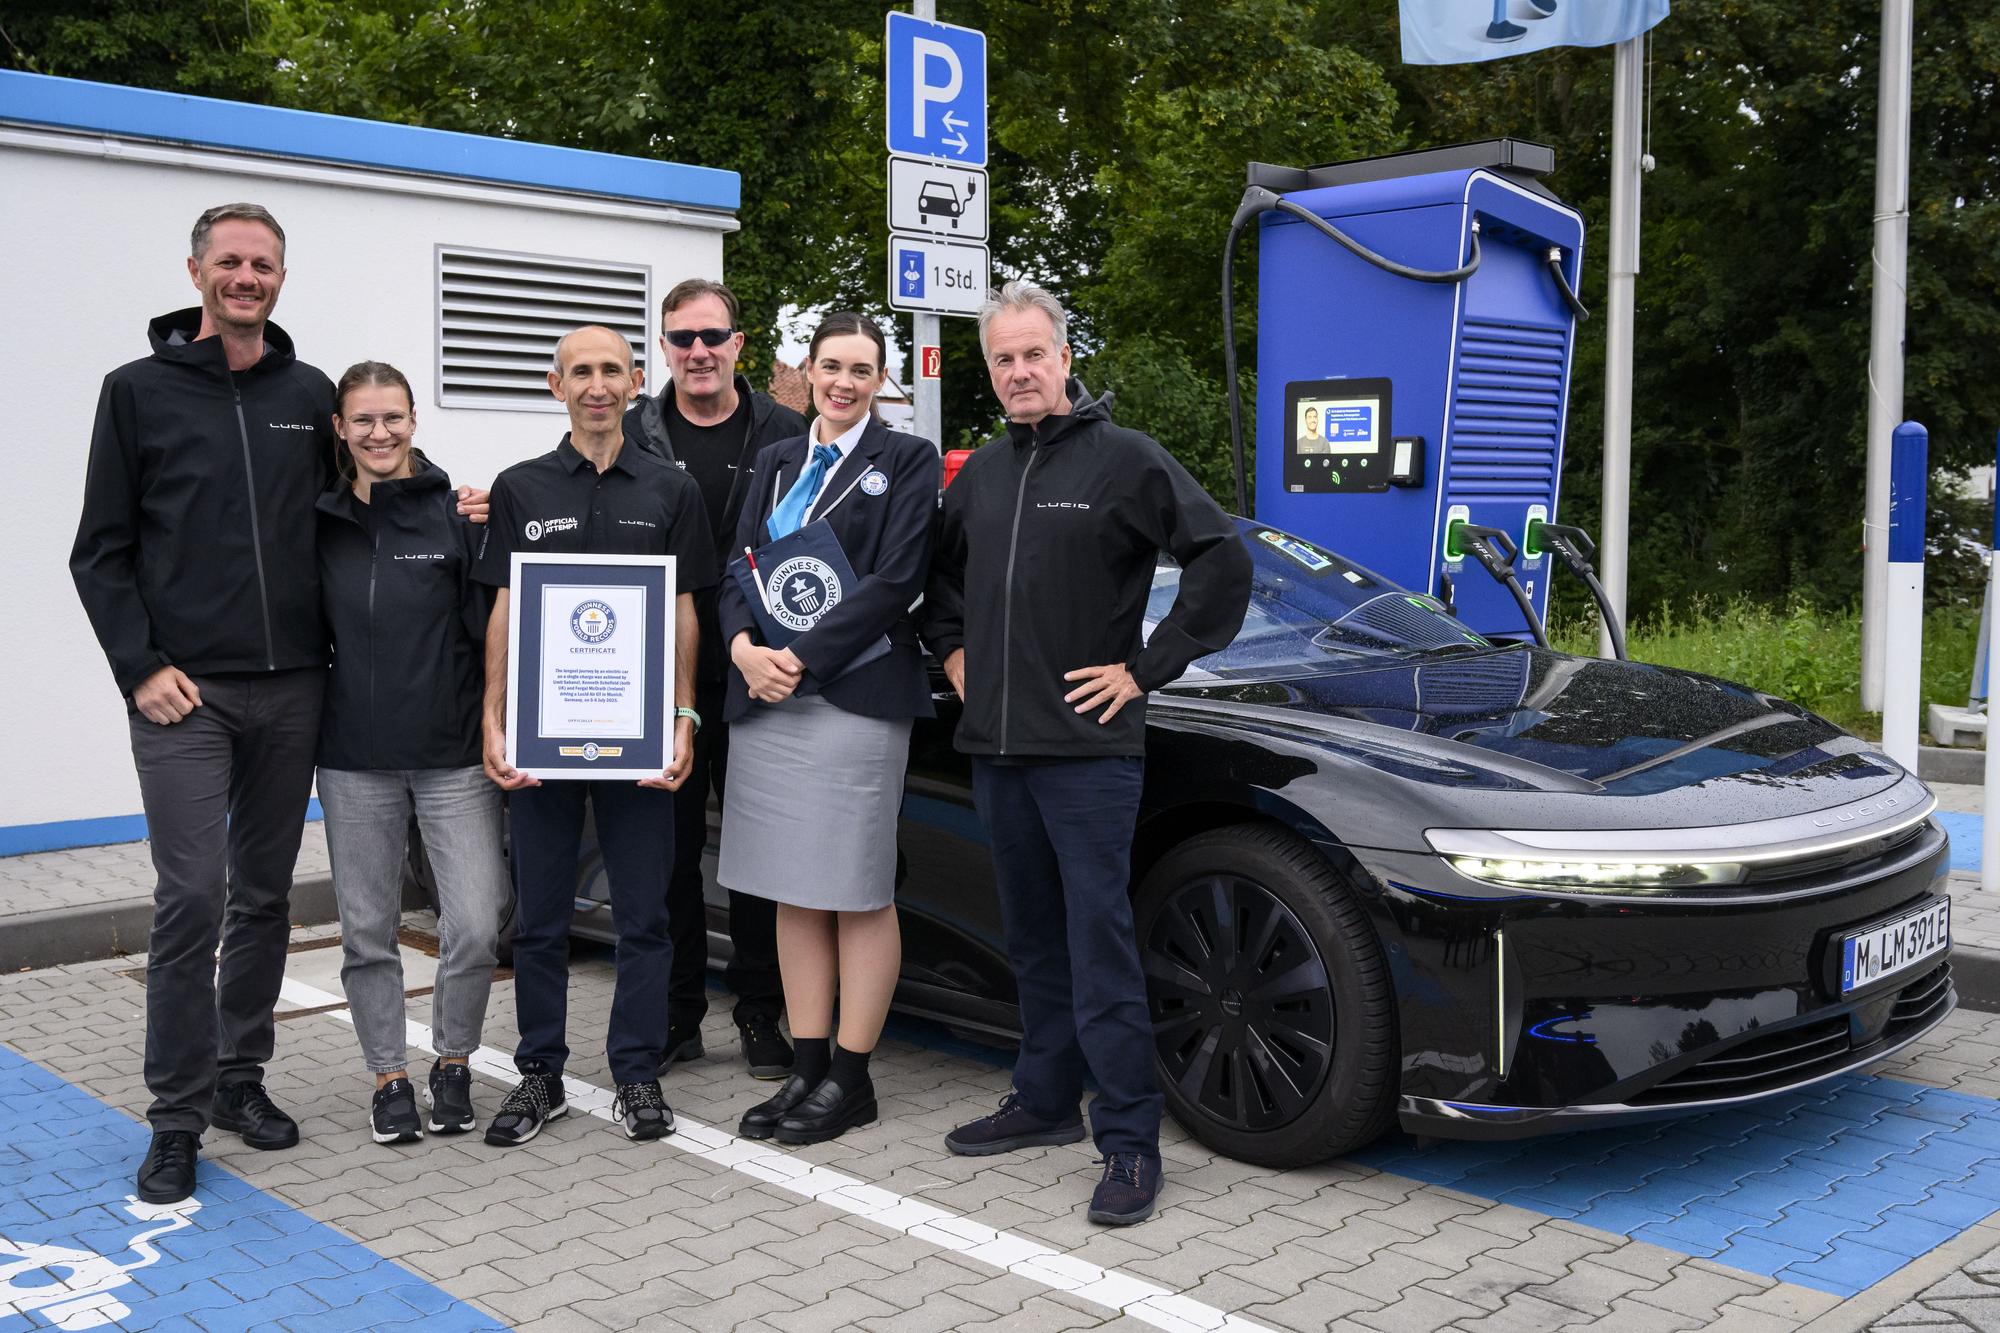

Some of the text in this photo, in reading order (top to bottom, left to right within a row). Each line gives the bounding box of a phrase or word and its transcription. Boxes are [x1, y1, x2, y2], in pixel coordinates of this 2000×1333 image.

[913, 36, 963, 138] P
[934, 266, 977, 290] 1 Std.
[544, 517, 578, 527] OFFICIAL
[545, 522, 578, 534] ATTEMPT
[1473, 542, 1493, 559] HPC
[1552, 540, 1572, 557] HPC
[772, 561, 820, 592] GUINNESS
[577, 602, 611, 614] GUINNESS
[774, 601, 808, 626] WORLD
[573, 618, 614, 642] WORLD RECORDS
[1812, 797, 1899, 828] LUCID
